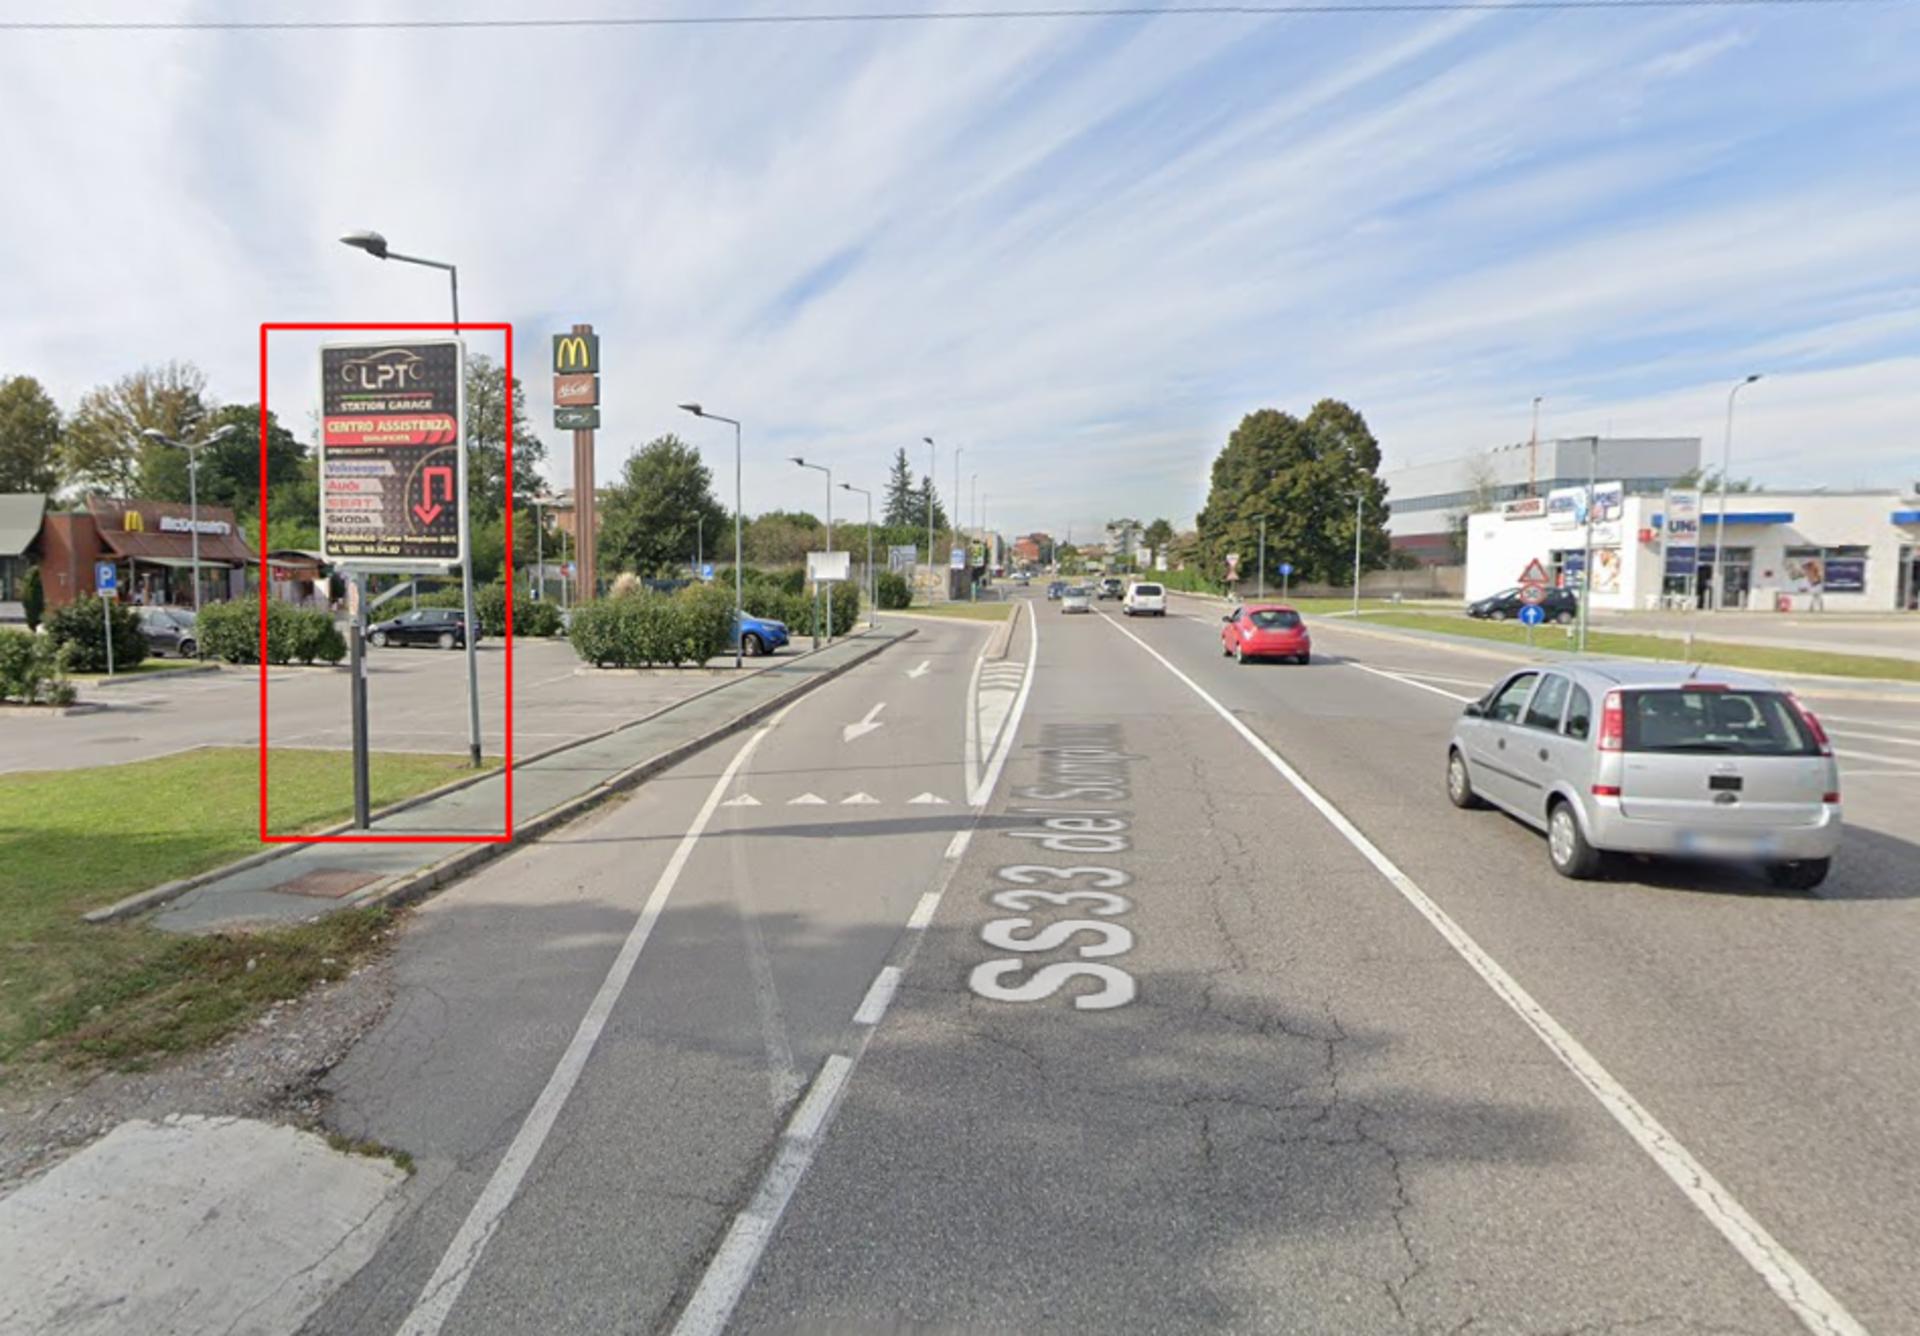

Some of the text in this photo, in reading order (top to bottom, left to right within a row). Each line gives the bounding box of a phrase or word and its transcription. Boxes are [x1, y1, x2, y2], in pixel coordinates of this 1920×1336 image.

[361, 364, 408, 389] LPT
[341, 400, 433, 412] STATION GARAGE
[327, 419, 452, 433] CENTRO ASSISTENZA
[327, 498, 374, 508] SEAT
[101, 567, 112, 586] P
